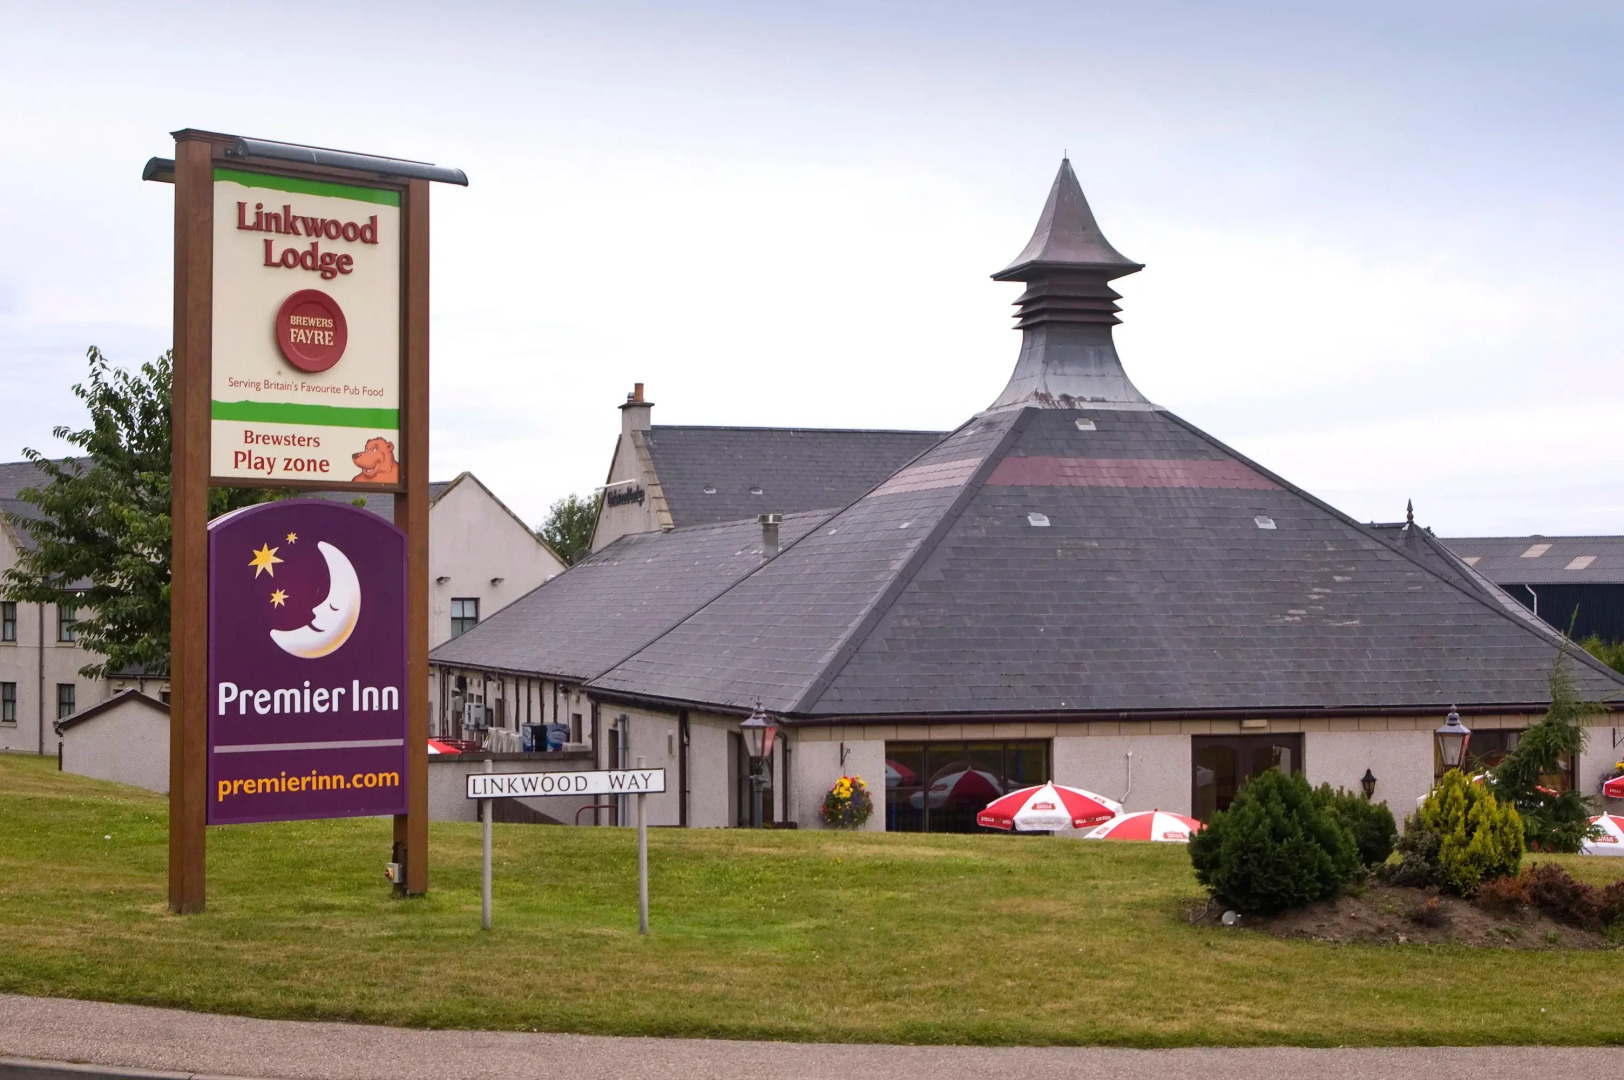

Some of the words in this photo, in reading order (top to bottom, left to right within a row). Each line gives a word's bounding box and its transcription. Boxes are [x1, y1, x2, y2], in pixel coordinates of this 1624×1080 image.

[237, 202, 379, 244] Linkwood
[263, 239, 354, 280] Lodge
[290, 315, 334, 328] BREWERS
[290, 328, 334, 346] FAYRE
[228, 377, 262, 391] Serving
[263, 379, 298, 391] Britain's
[301, 382, 341, 394] Favourite
[344, 385, 360, 395] Pub
[363, 386, 384, 397] Food
[244, 430, 321, 448] Brewsters
[233, 449, 277, 475] Play
[283, 457, 330, 473] zone
[218, 680, 346, 715] Premier
[352, 679, 399, 712] Inn
[218, 769, 399, 802] premierinn.com
[472, 775, 588, 795] LINKWOOD
[608, 773, 653, 790] WAY
